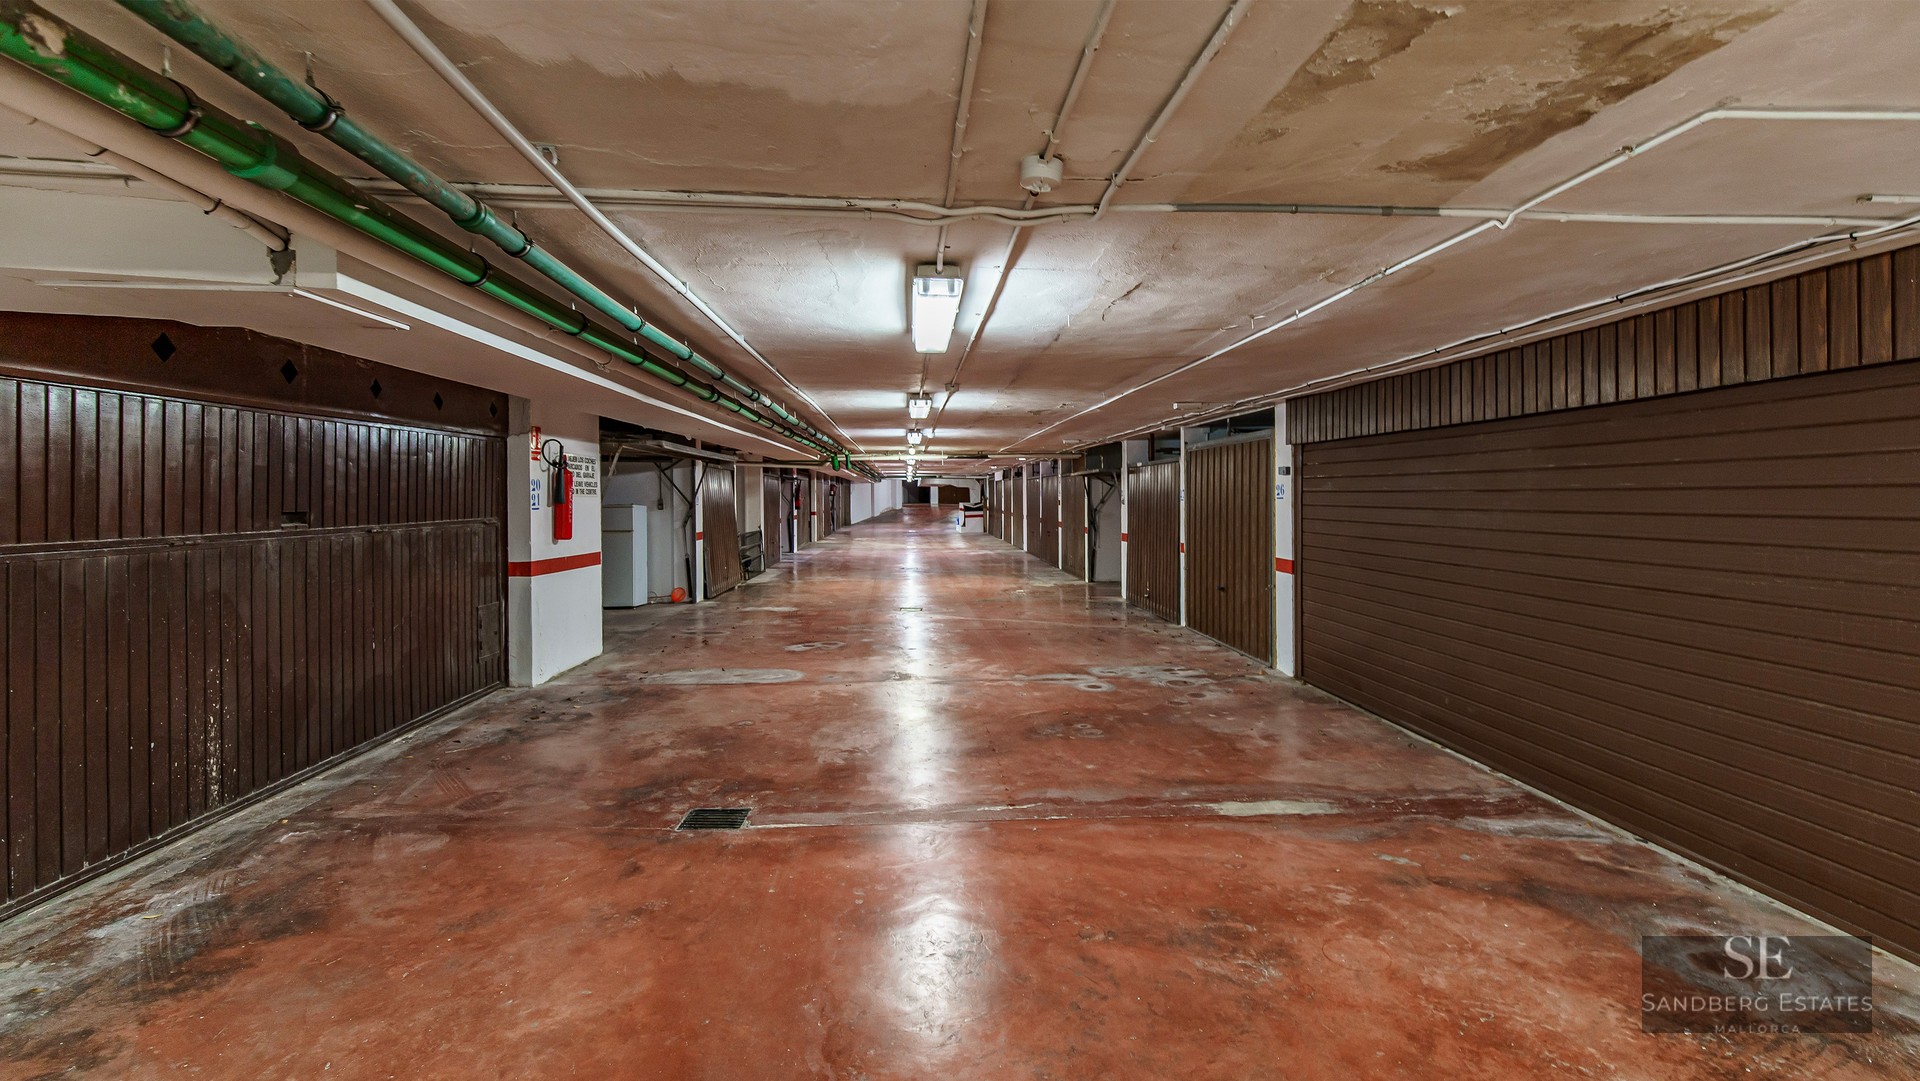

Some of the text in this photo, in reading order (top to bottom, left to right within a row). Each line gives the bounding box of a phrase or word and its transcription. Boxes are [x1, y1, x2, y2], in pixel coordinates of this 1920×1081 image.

[531, 479, 541, 491] 20
[574, 480, 584, 488] LEAVE
[1276, 483, 1285, 496] 26
[531, 493, 540, 506] 21
